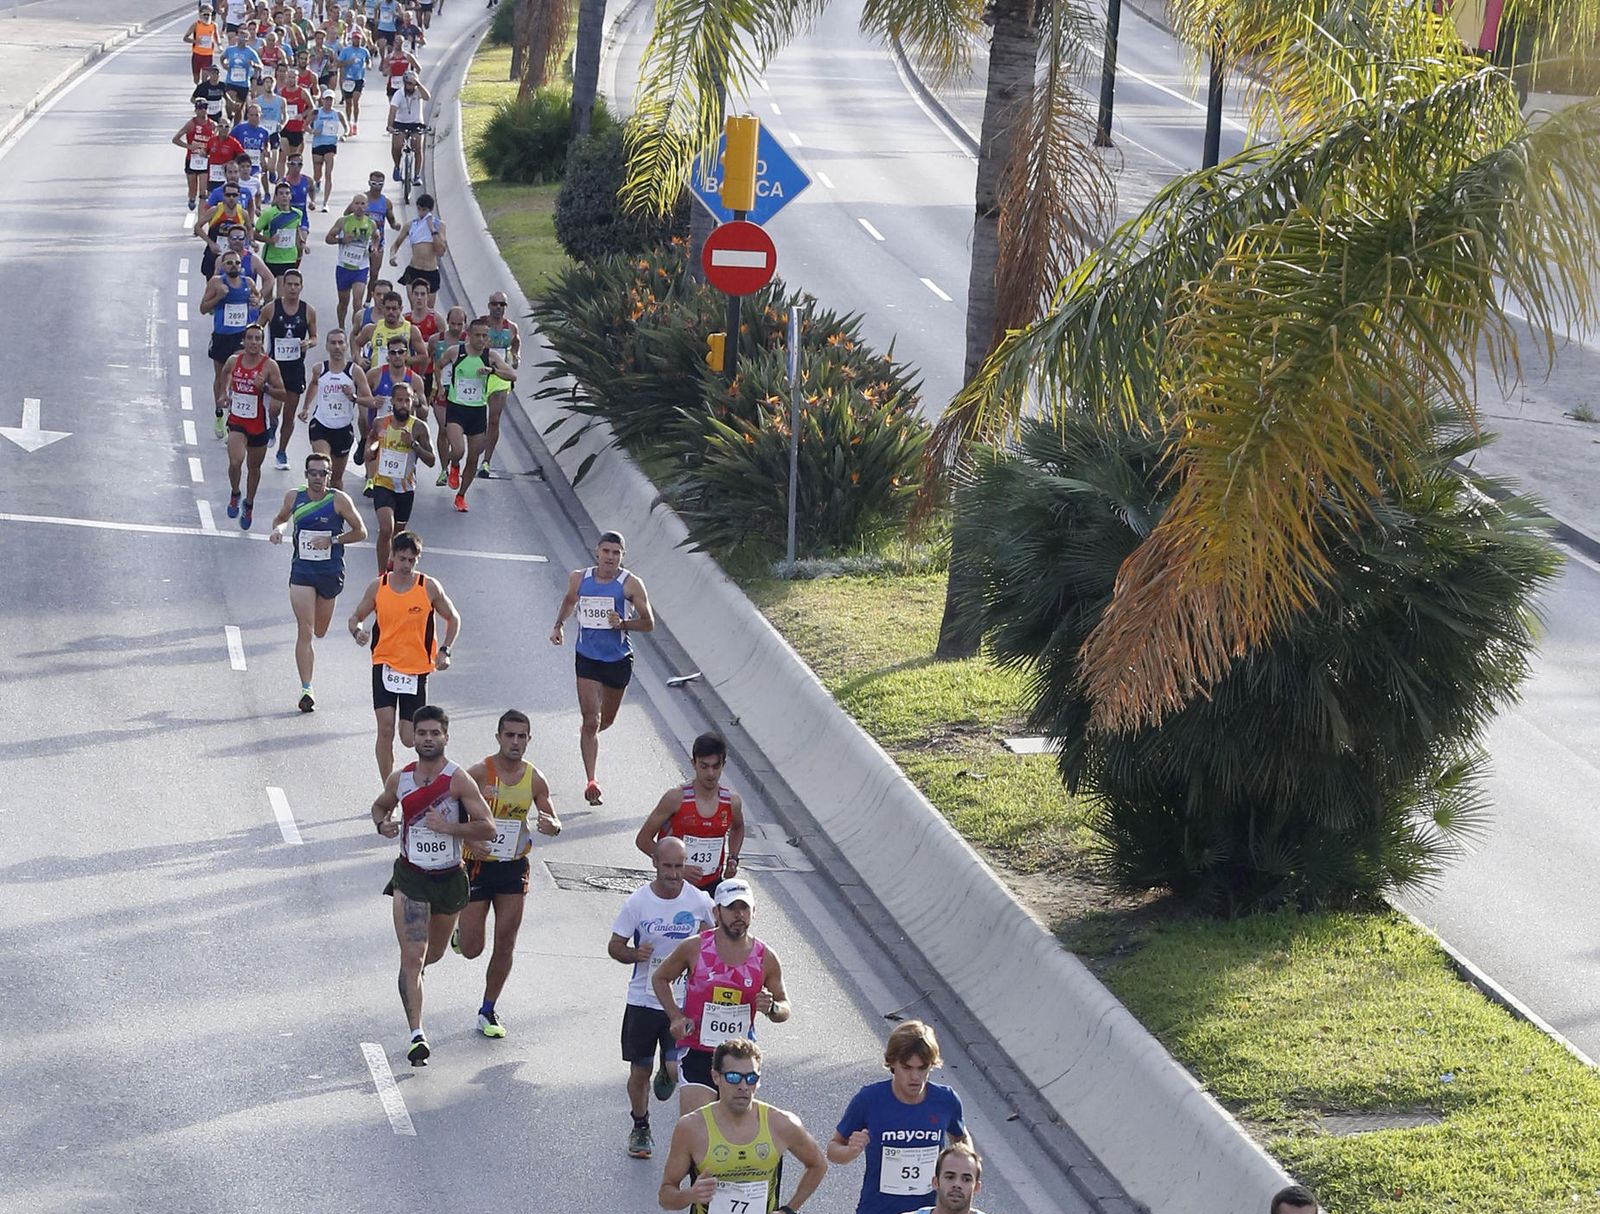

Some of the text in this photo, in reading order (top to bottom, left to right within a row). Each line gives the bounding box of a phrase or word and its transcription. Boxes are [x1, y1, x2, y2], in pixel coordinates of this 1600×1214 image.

[236, 402, 251, 410] 272
[384, 460, 399, 468] 169
[387, 674, 412, 684] 6812
[416, 841, 446, 853] 9086
[691, 852, 712, 863] 433
[710, 1020, 743, 1034] 6061
[882, 1129, 942, 1142] mayoral
[901, 1166, 920, 1179] 53
[730, 1199, 750, 1214] 77
